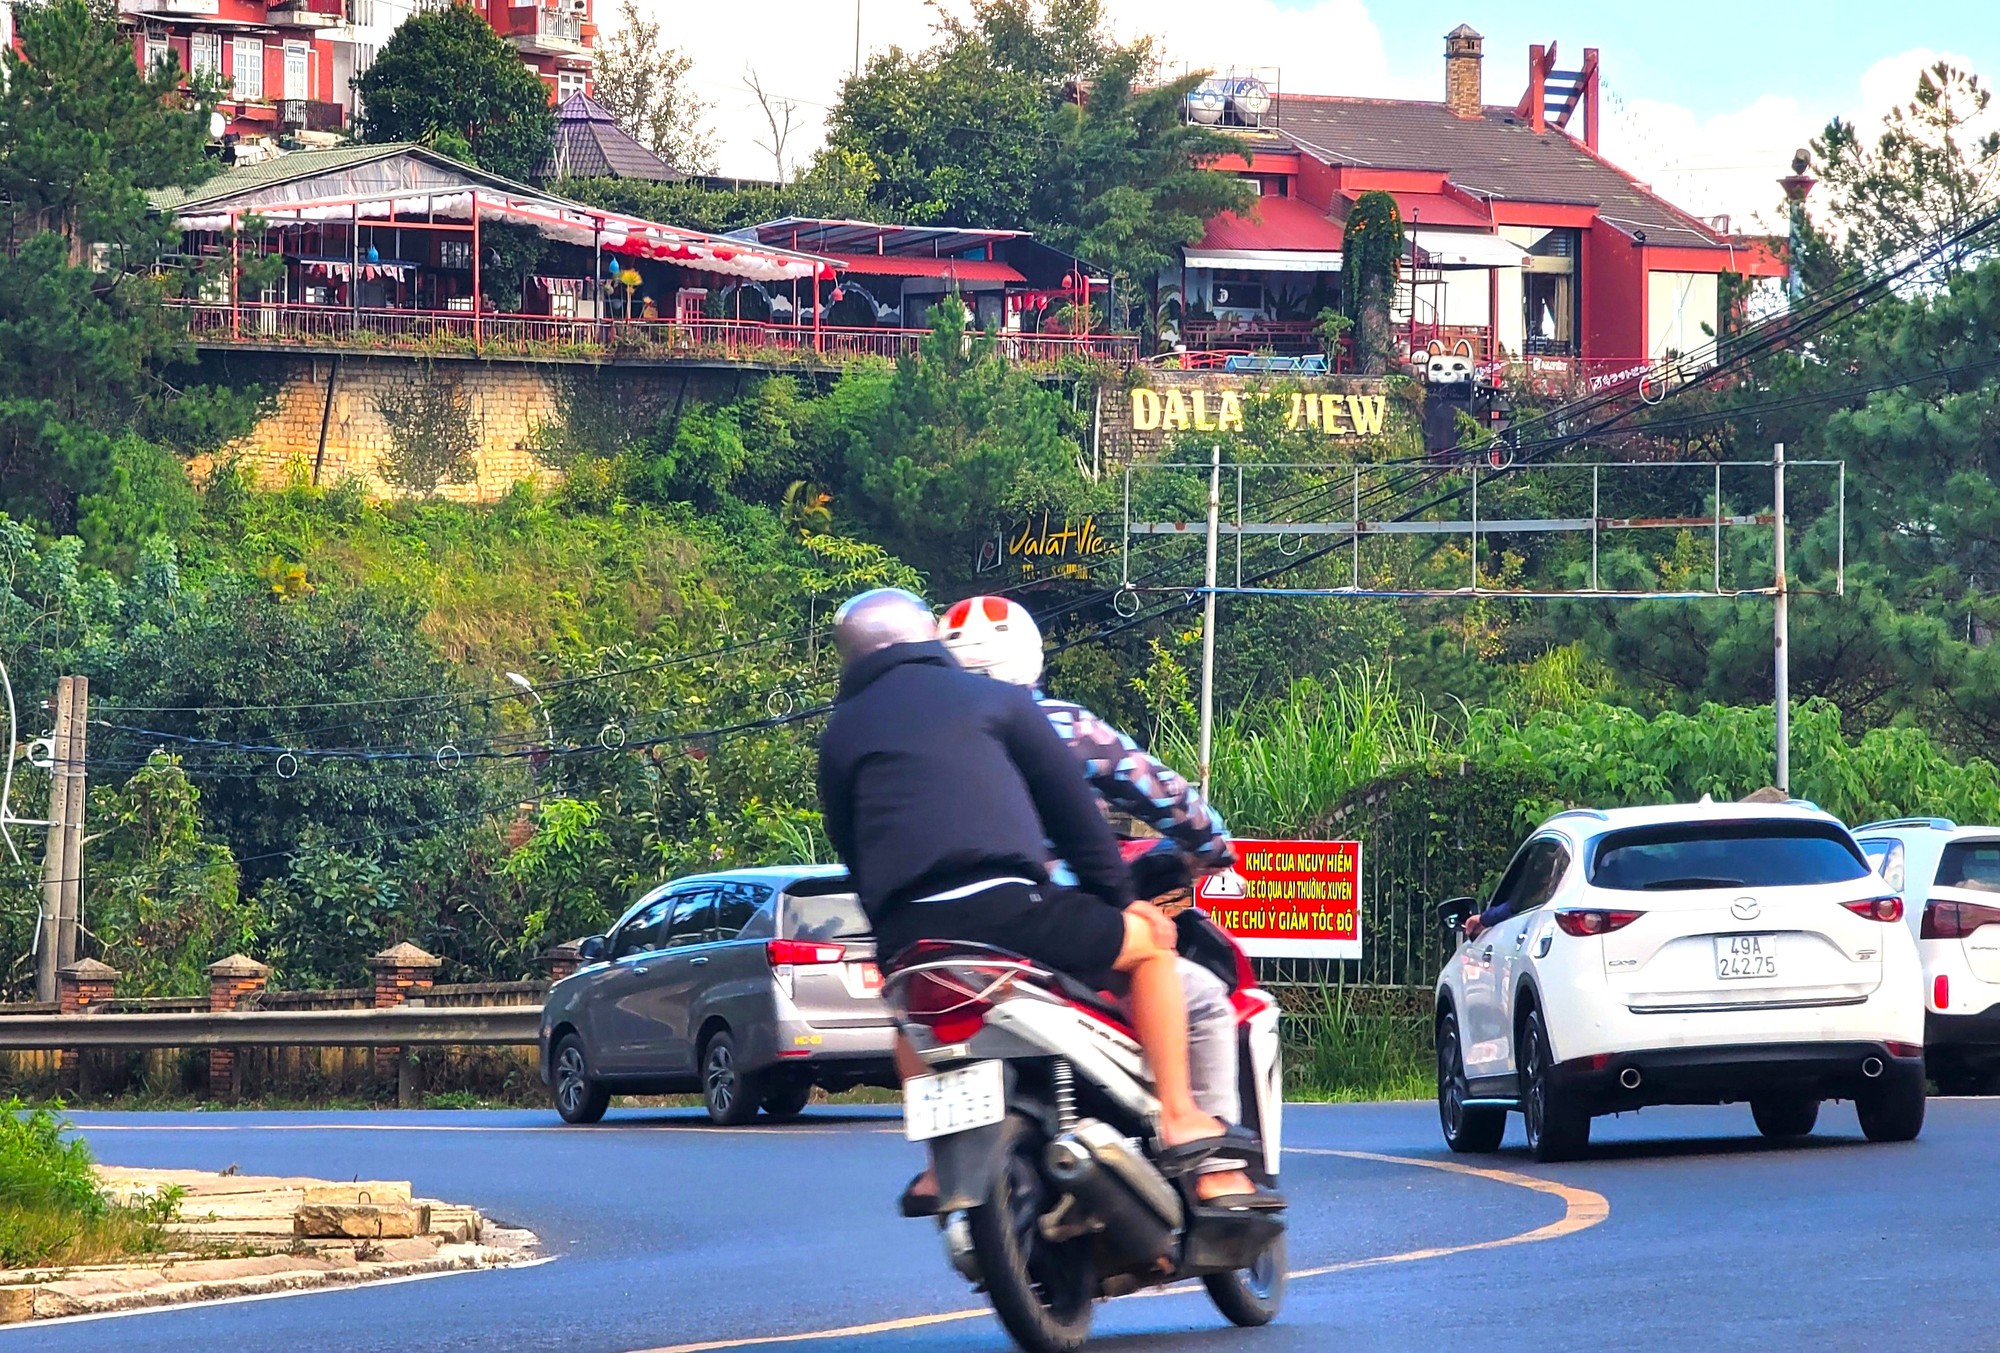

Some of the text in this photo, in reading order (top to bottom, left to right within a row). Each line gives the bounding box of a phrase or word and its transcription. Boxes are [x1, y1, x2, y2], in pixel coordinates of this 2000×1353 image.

[1246, 844, 1352, 872] KHÚC CUA NGUY HIỂM
[1246, 880, 1256, 898] XE
[1268, 880, 1282, 902] QUA
[1283, 881, 1295, 903] LẠI
[1297, 877, 1326, 899] THƯỜNG
[1327, 877, 1352, 900] XUYÊN
[1225, 910, 1239, 929] XE
[1242, 907, 1266, 929] CHÚ
[1268, 906, 1276, 929] Ý
[1279, 905, 1308, 930] GIẢM
[1311, 904, 1334, 931] TỐC
[1336, 909, 1353, 936] ĐỘ
[1731, 937, 1761, 955] 49A
[1720, 957, 1775, 976] 242.75
